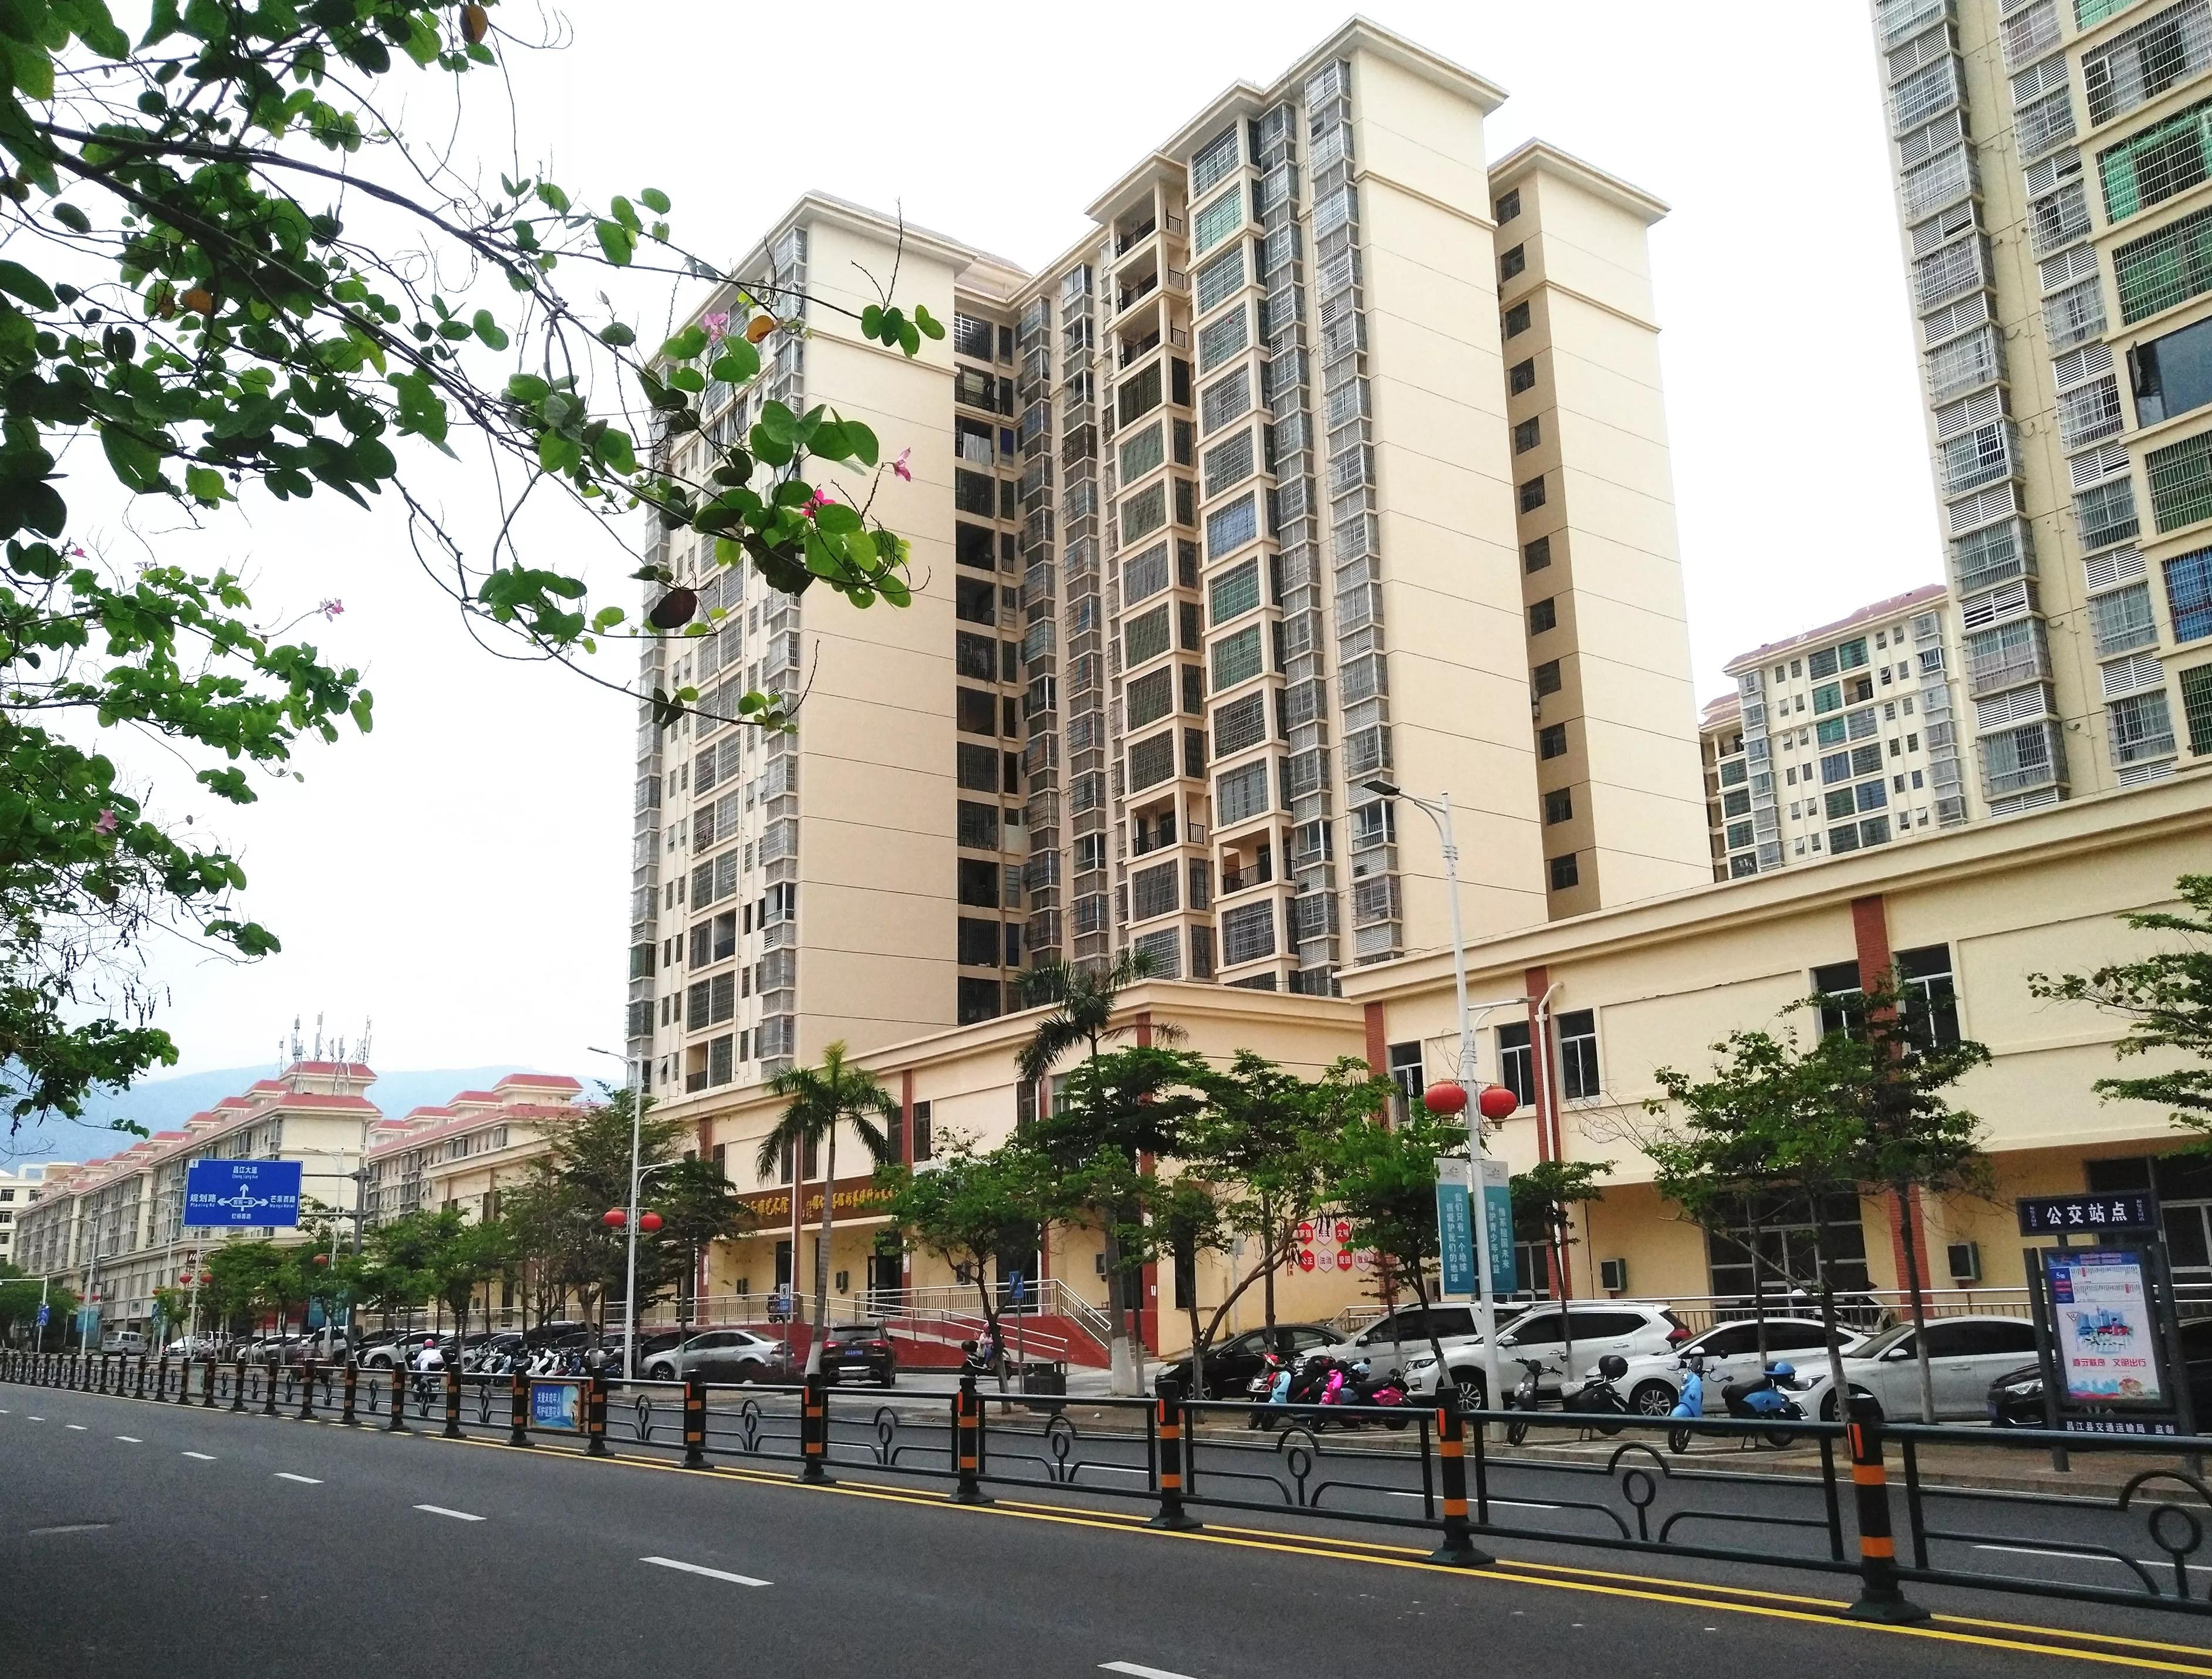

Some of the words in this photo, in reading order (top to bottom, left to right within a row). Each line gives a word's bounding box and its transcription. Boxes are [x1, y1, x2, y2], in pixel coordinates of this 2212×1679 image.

[233, 1165, 258, 1174] 昌江大道
[190, 1193, 216, 1202] 规划路
[2046, 1201, 2127, 1225] 公交站点
[1337, 1229, 1349, 1237] 文明
[1455, 1192, 1467, 1272] 我们只有一个地球
[1488, 1201, 1500, 1274] 保护青少年权益
[1319, 1256, 1332, 1264] 法治
[1339, 1256, 1351, 1264] 爱国
[2113, 1358, 2146, 1367] 文明出行
[537, 1392, 560, 1403] 关爱未成年人
[2066, 1421, 2146, 1434] 昌江县交通运输局
[2155, 1424, 2174, 1434] 监制
